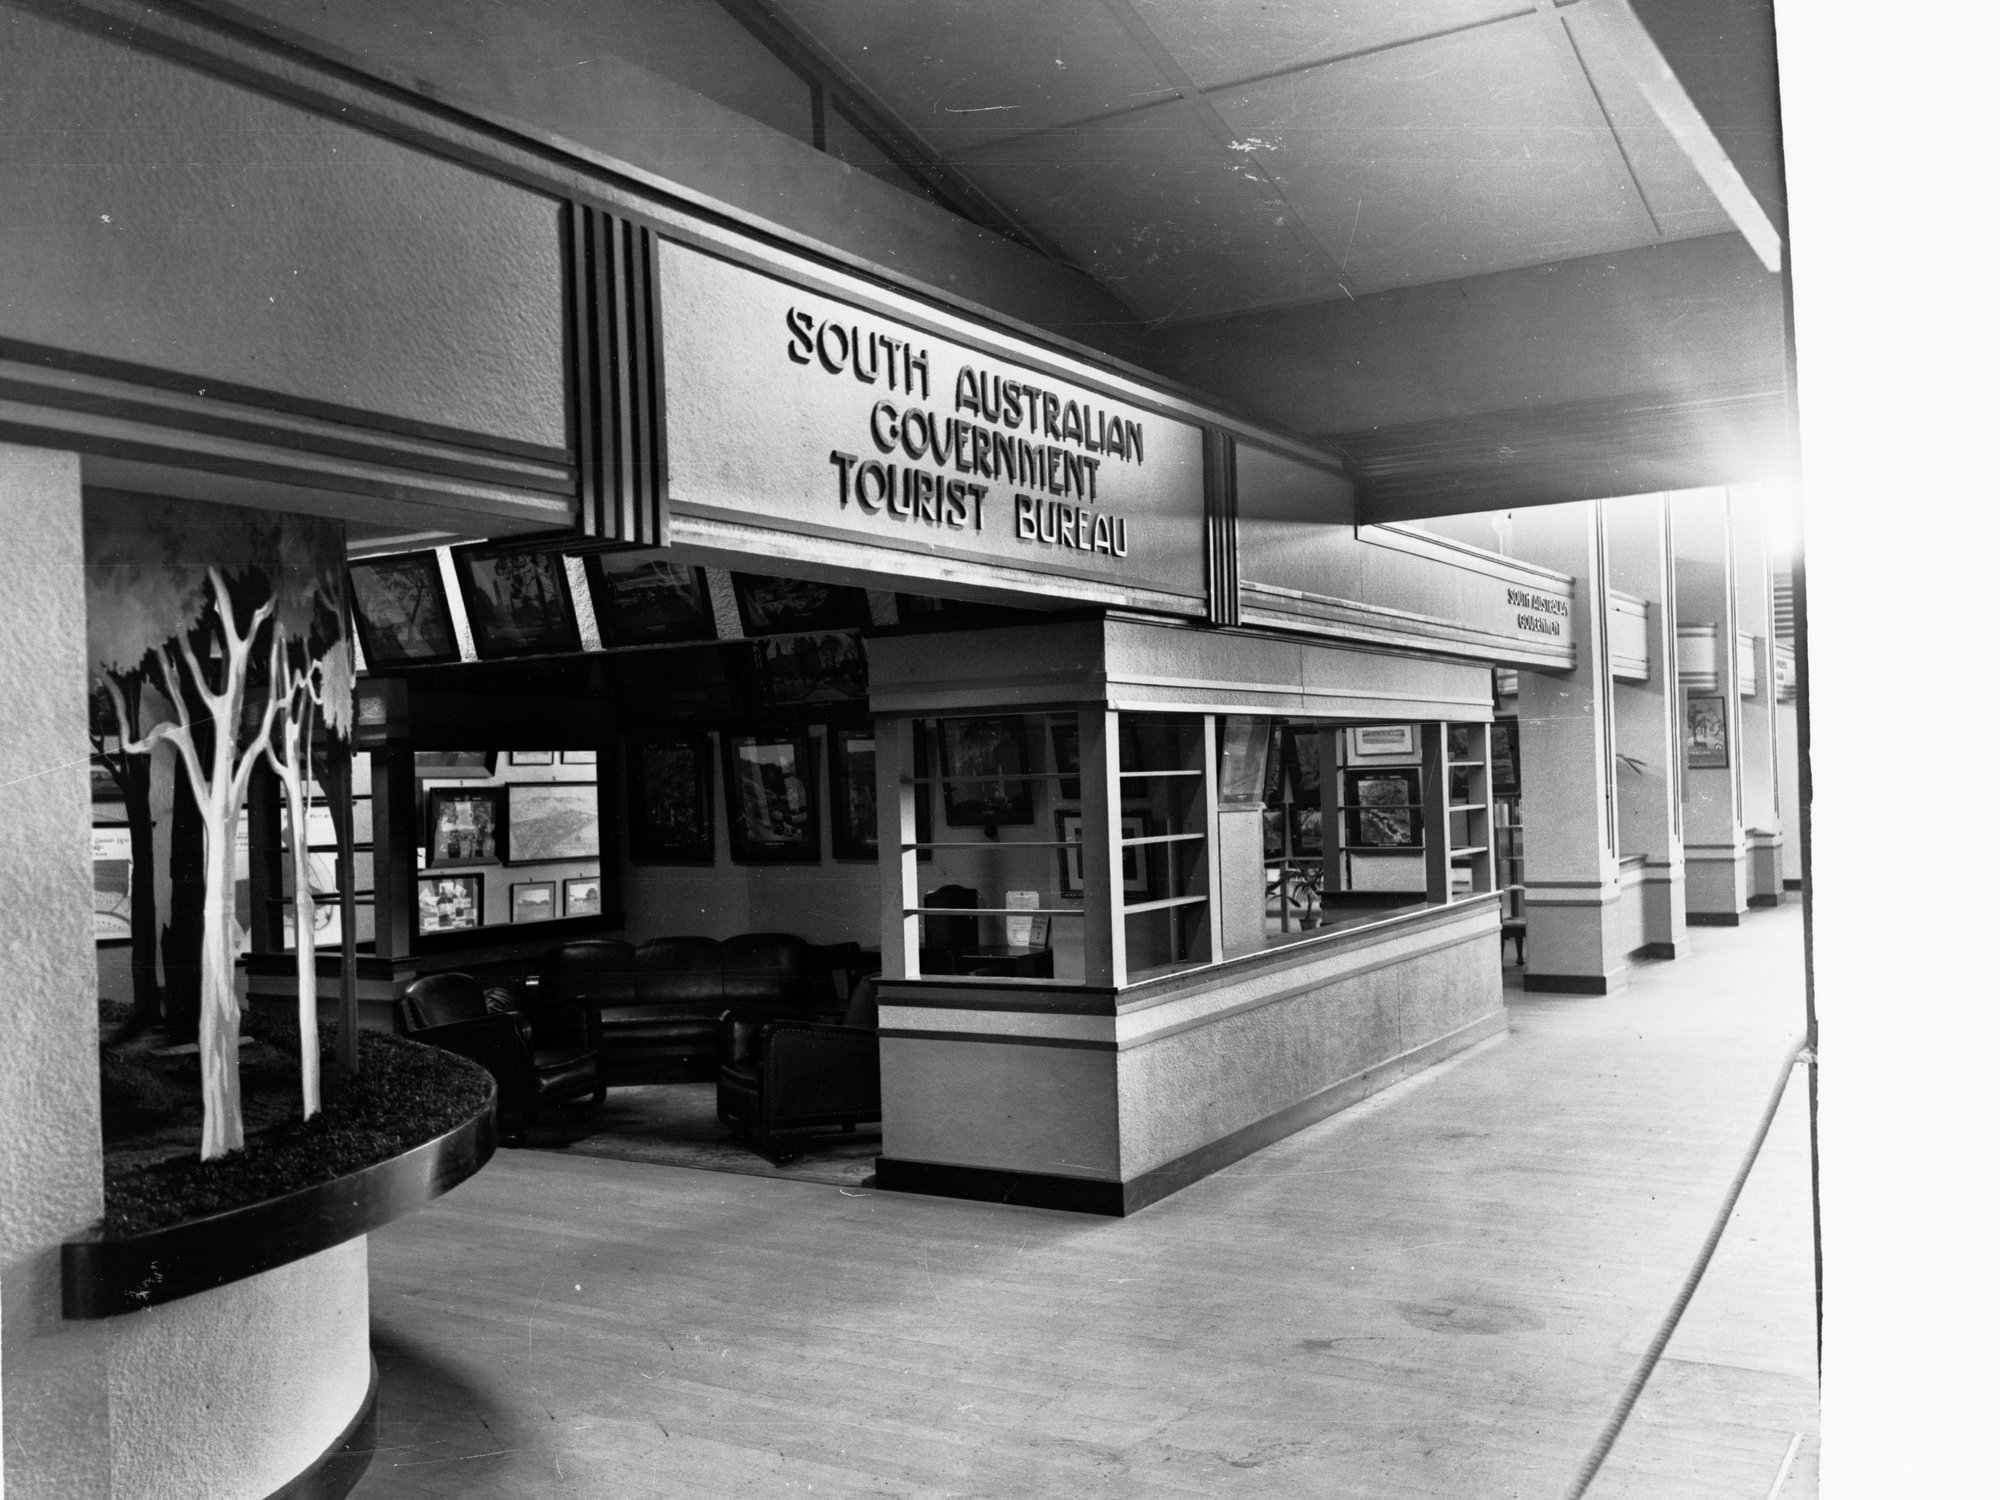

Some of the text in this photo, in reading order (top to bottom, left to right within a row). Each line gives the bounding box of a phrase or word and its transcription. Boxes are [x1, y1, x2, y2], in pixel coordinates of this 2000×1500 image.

[786, 306, 1144, 465] SOUTH AUSTRALIAN
[830, 450, 1128, 557] TOURIST BUREAU
[871, 399, 1101, 504] GOVERNMENT
[1507, 588, 1569, 616] SOUTH AUSTRALIAN
[1517, 613, 1560, 636] GOVERNMENT
